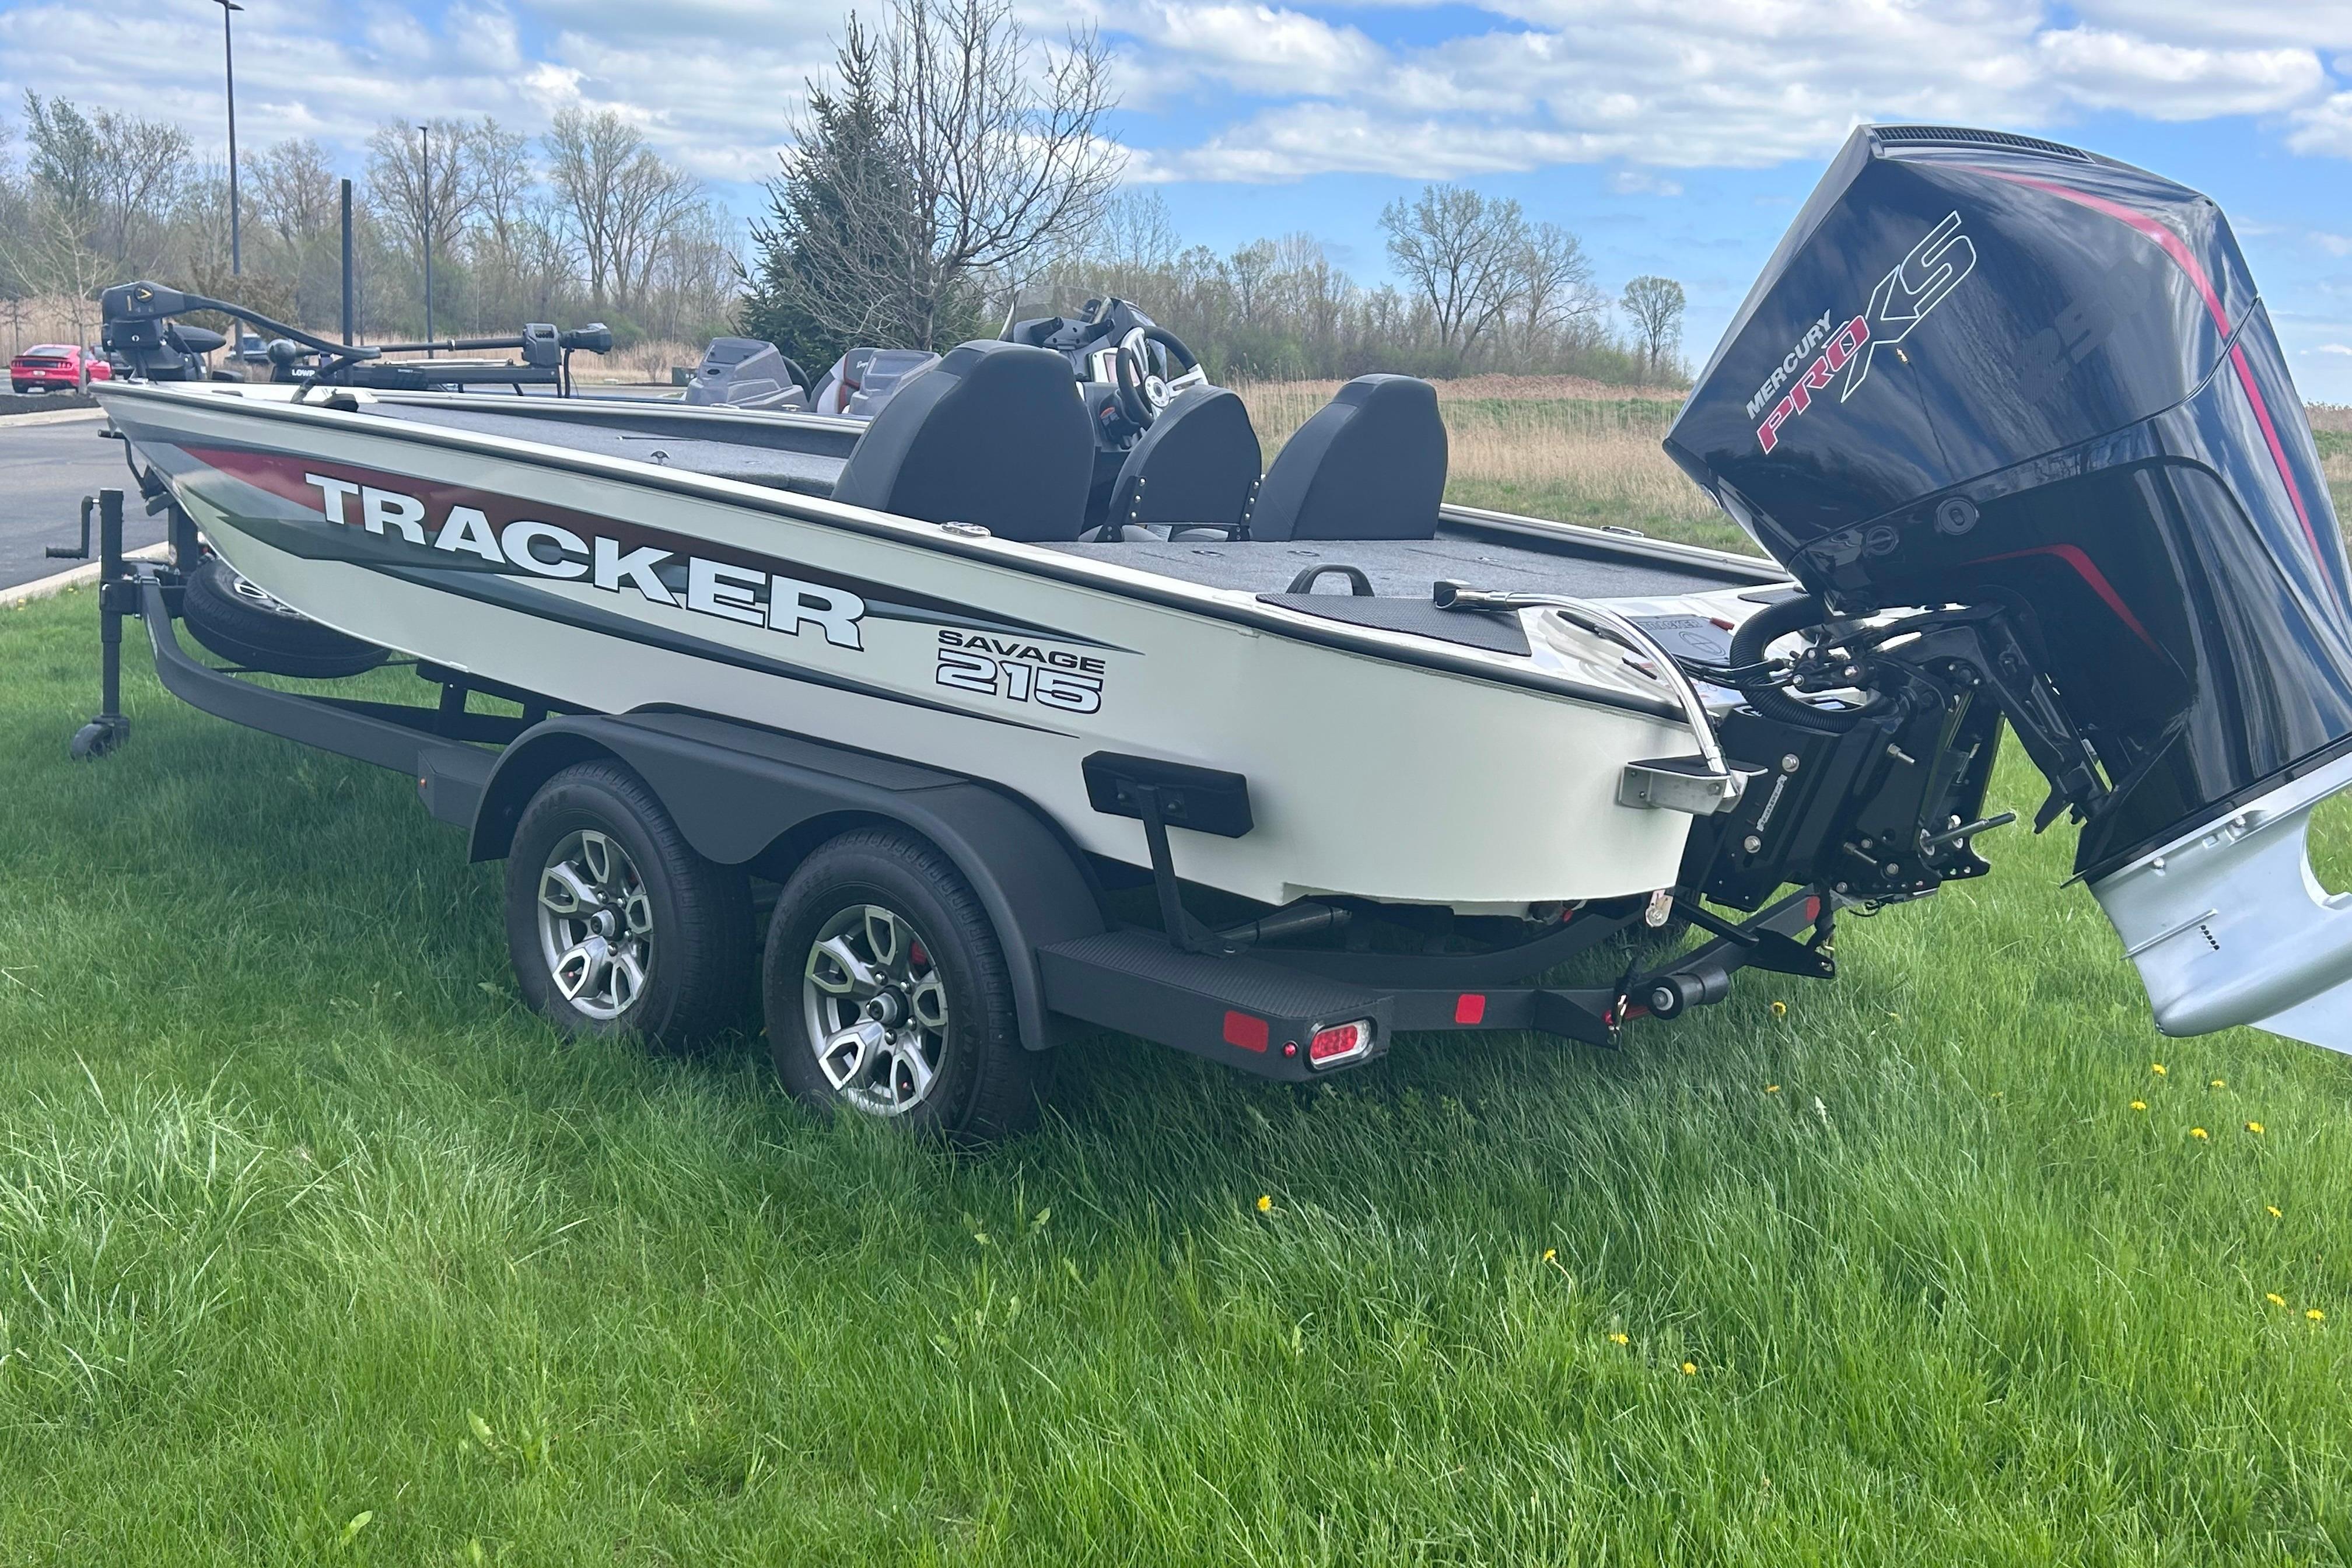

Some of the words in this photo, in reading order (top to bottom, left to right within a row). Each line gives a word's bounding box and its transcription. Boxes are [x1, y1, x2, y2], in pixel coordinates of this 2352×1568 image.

[1746, 309, 1831, 420] MERCURY
[1756, 315, 1870, 455] PRO
[304, 473, 865, 652] TRACKER
[936, 648, 1104, 715] 215
[938, 630, 1106, 674] SAVAGE
